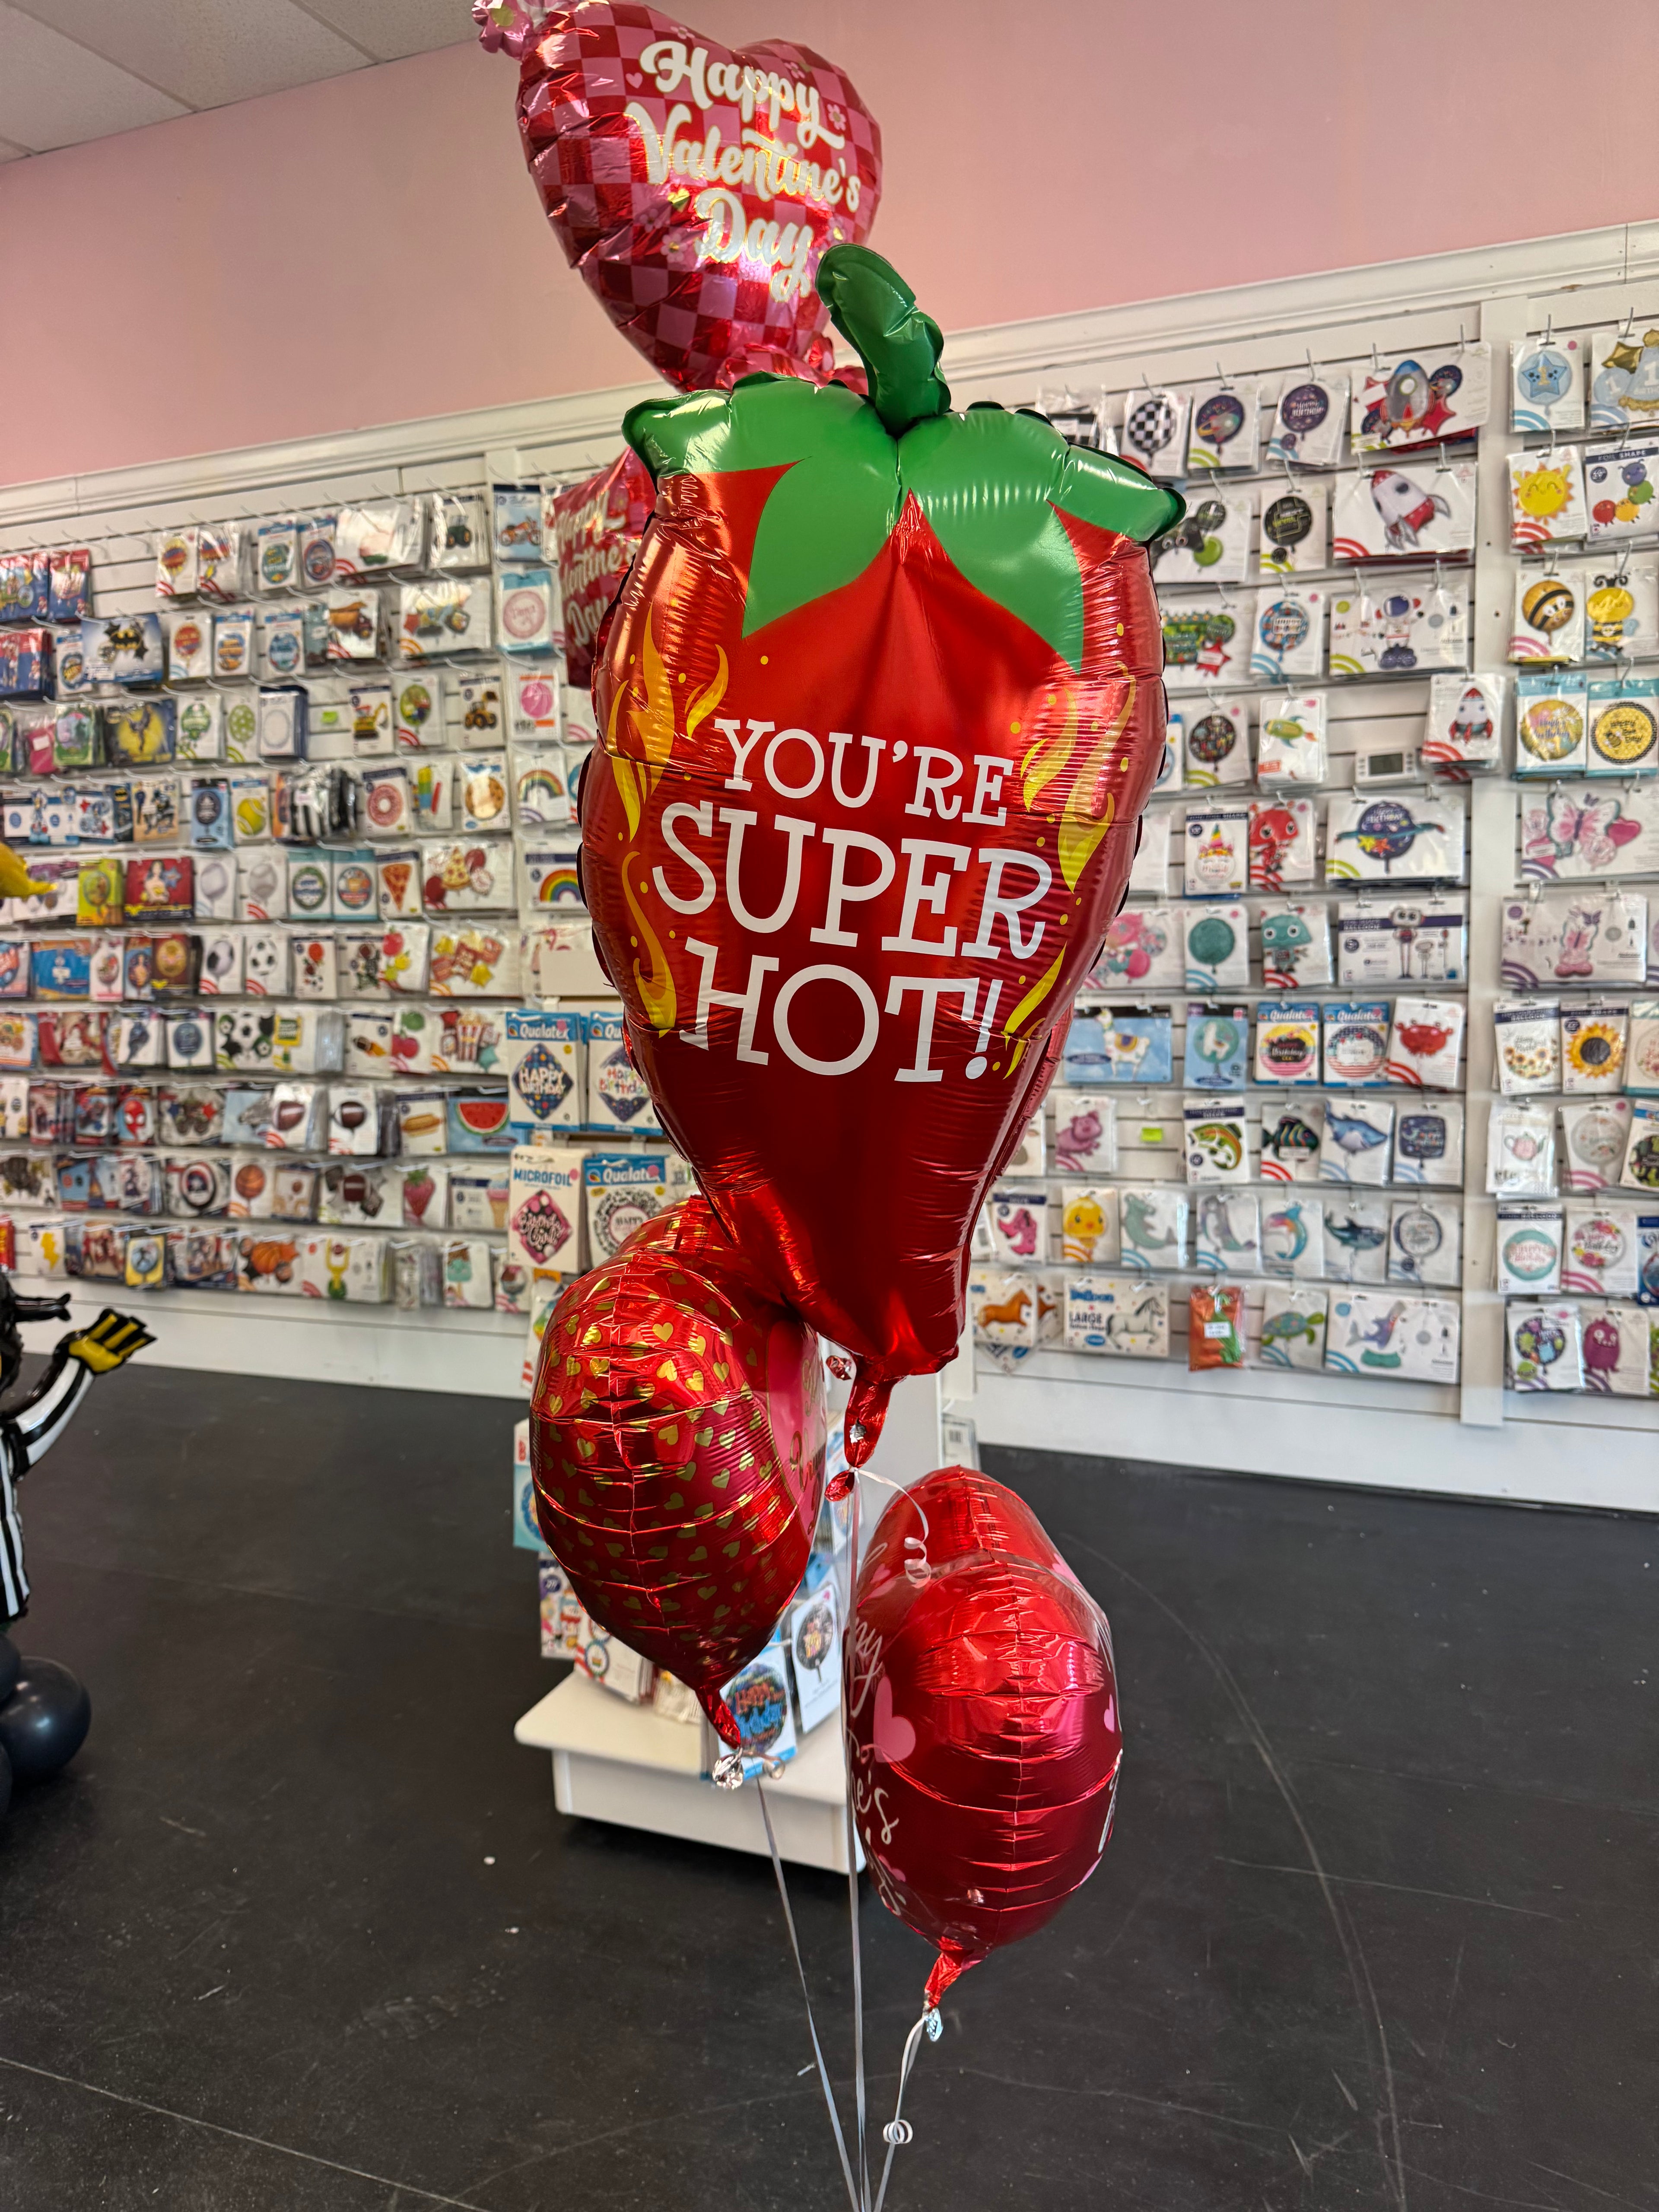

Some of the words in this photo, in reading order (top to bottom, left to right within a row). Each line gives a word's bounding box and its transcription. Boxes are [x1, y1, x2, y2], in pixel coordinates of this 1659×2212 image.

[640, 41, 845, 150] Happy
[624, 102, 860, 213] Valentine's
[694, 187, 814, 303] Day
[715, 719, 1014, 826] YOU'RE
[652, 800, 1052, 960] SUPER
[679, 936, 1004, 1083] HOT!
[513, 1168, 572, 1186] MICROFOIL
[602, 1166, 660, 1182] Qualat
